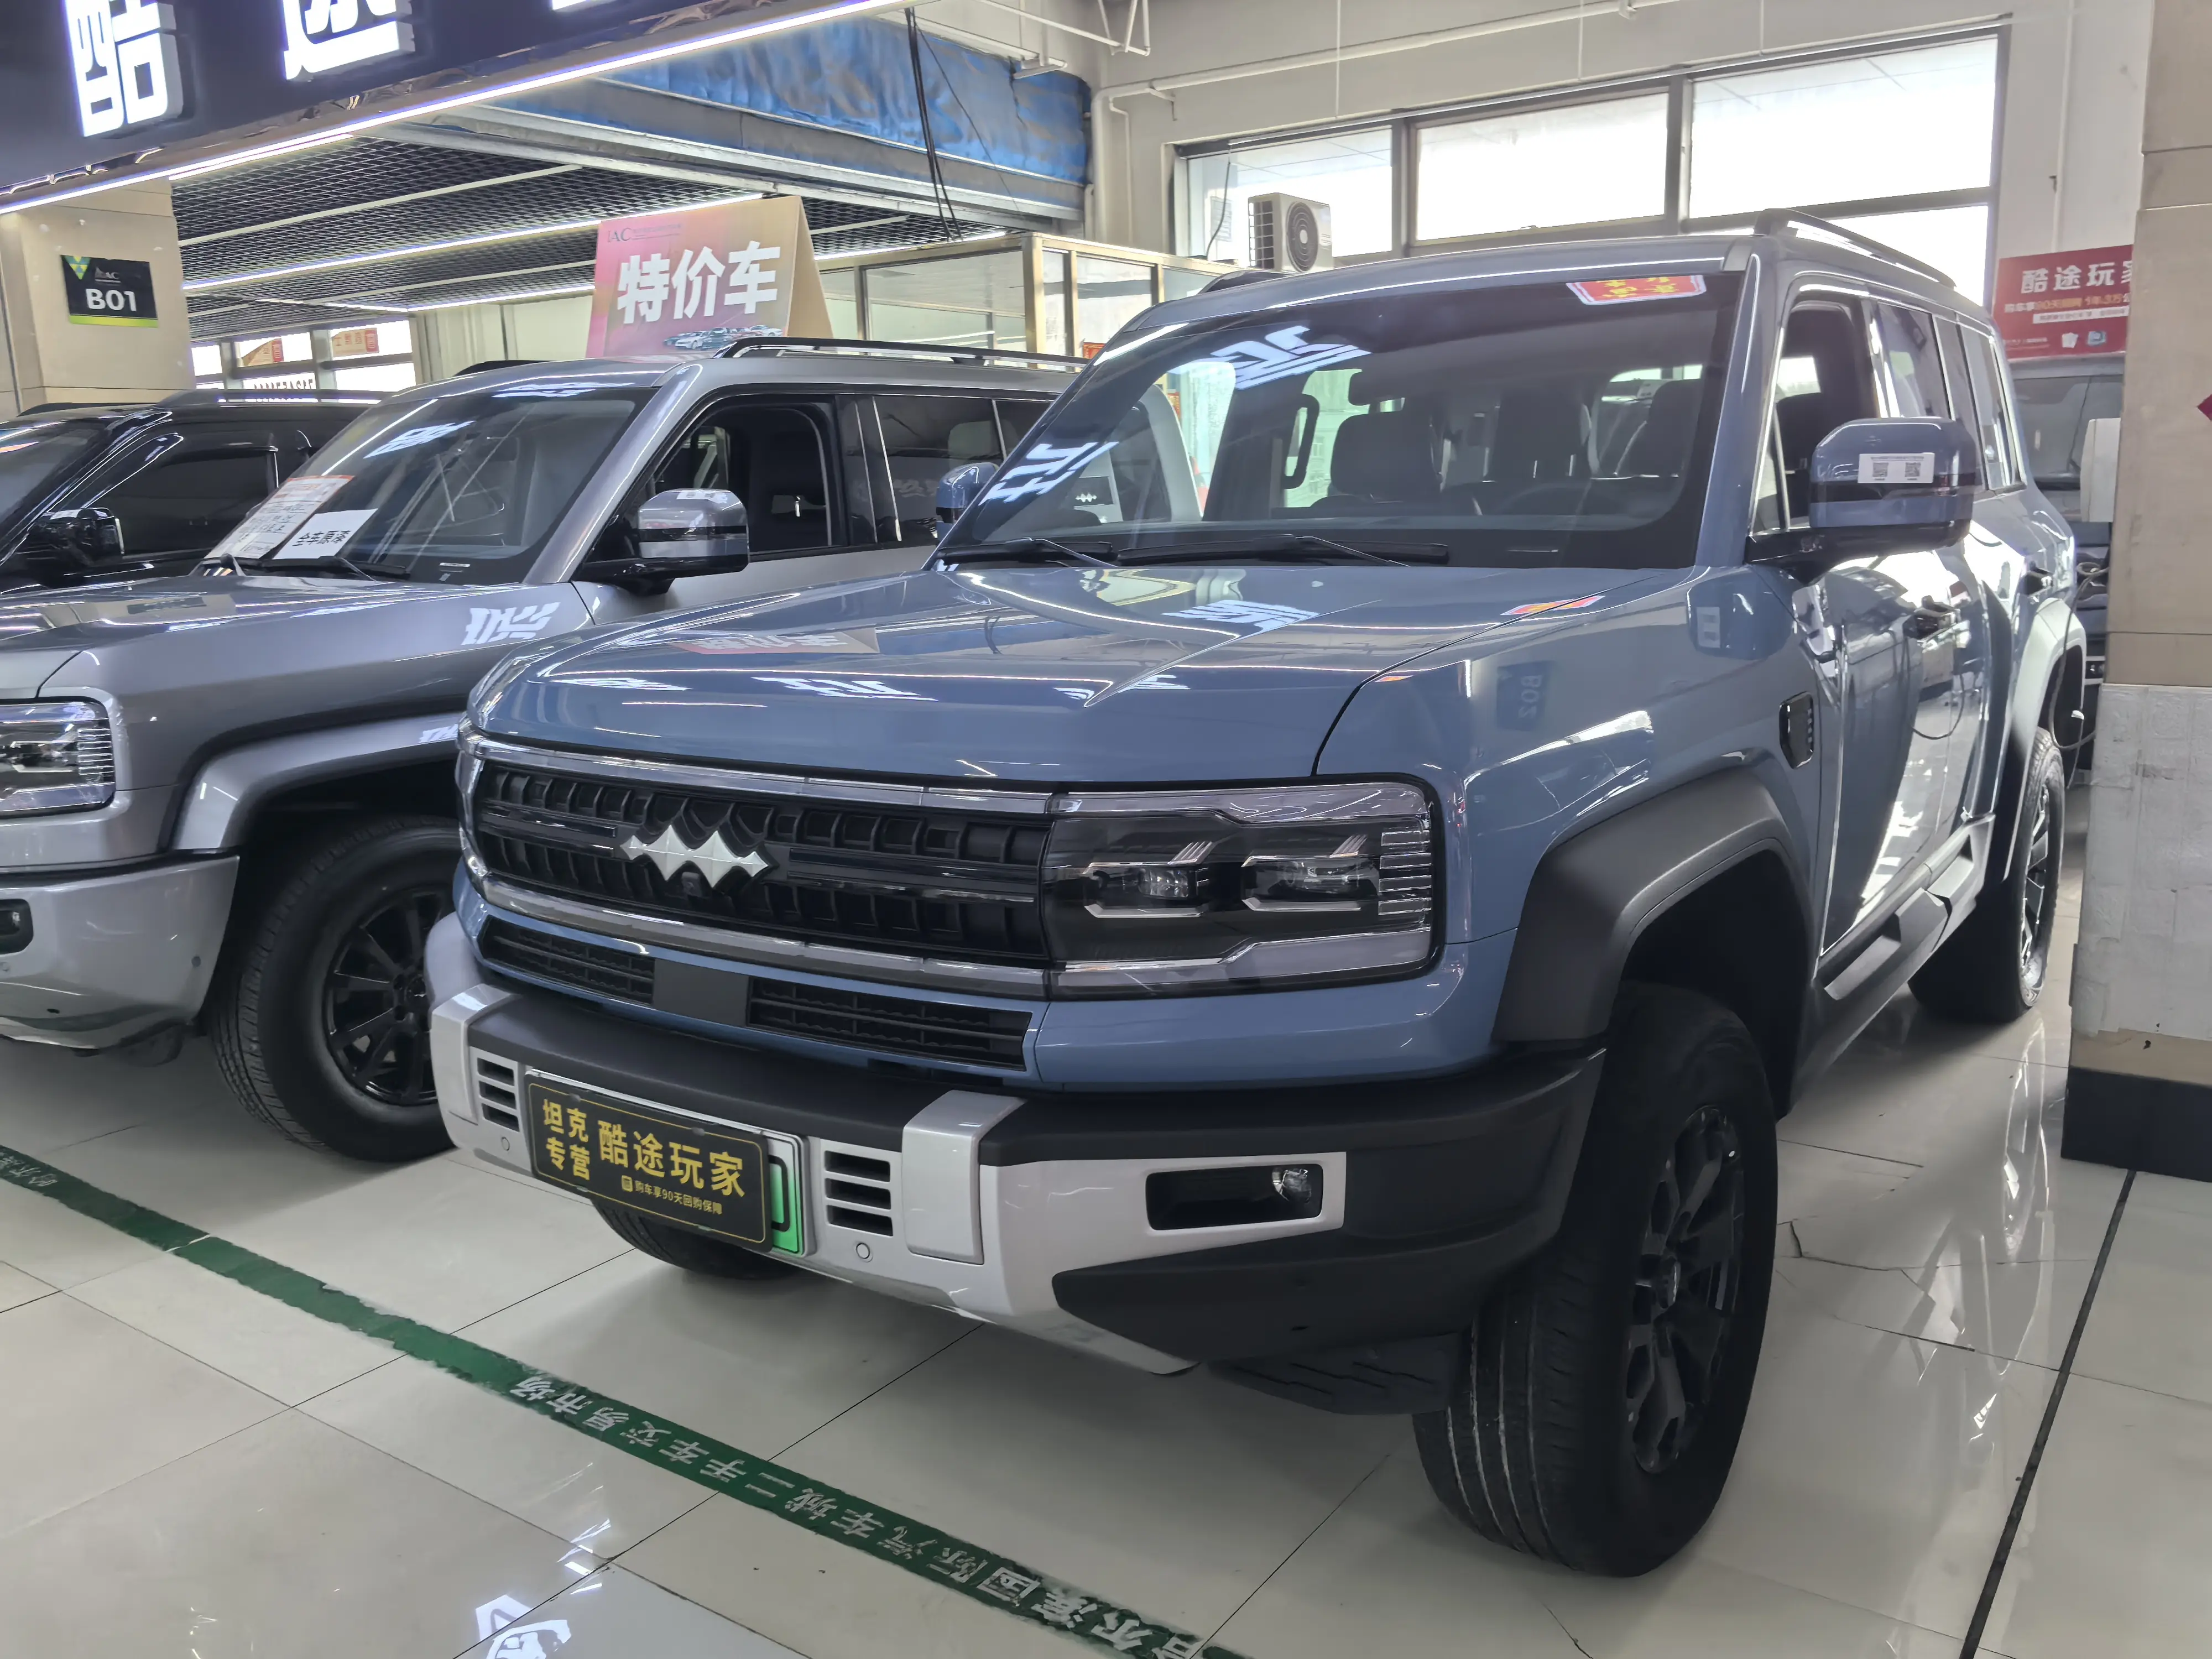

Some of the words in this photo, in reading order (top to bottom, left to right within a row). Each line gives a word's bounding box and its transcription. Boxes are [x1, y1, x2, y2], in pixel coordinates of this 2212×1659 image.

[85, 288, 137, 312] B01
[617, 240, 781, 325] 特价车
[292, 529, 352, 546] 全车原漆
[542, 1098, 589, 1142] 坦克
[545, 1136, 590, 1181] 专营
[598, 1119, 745, 1198] 酷途玩家
